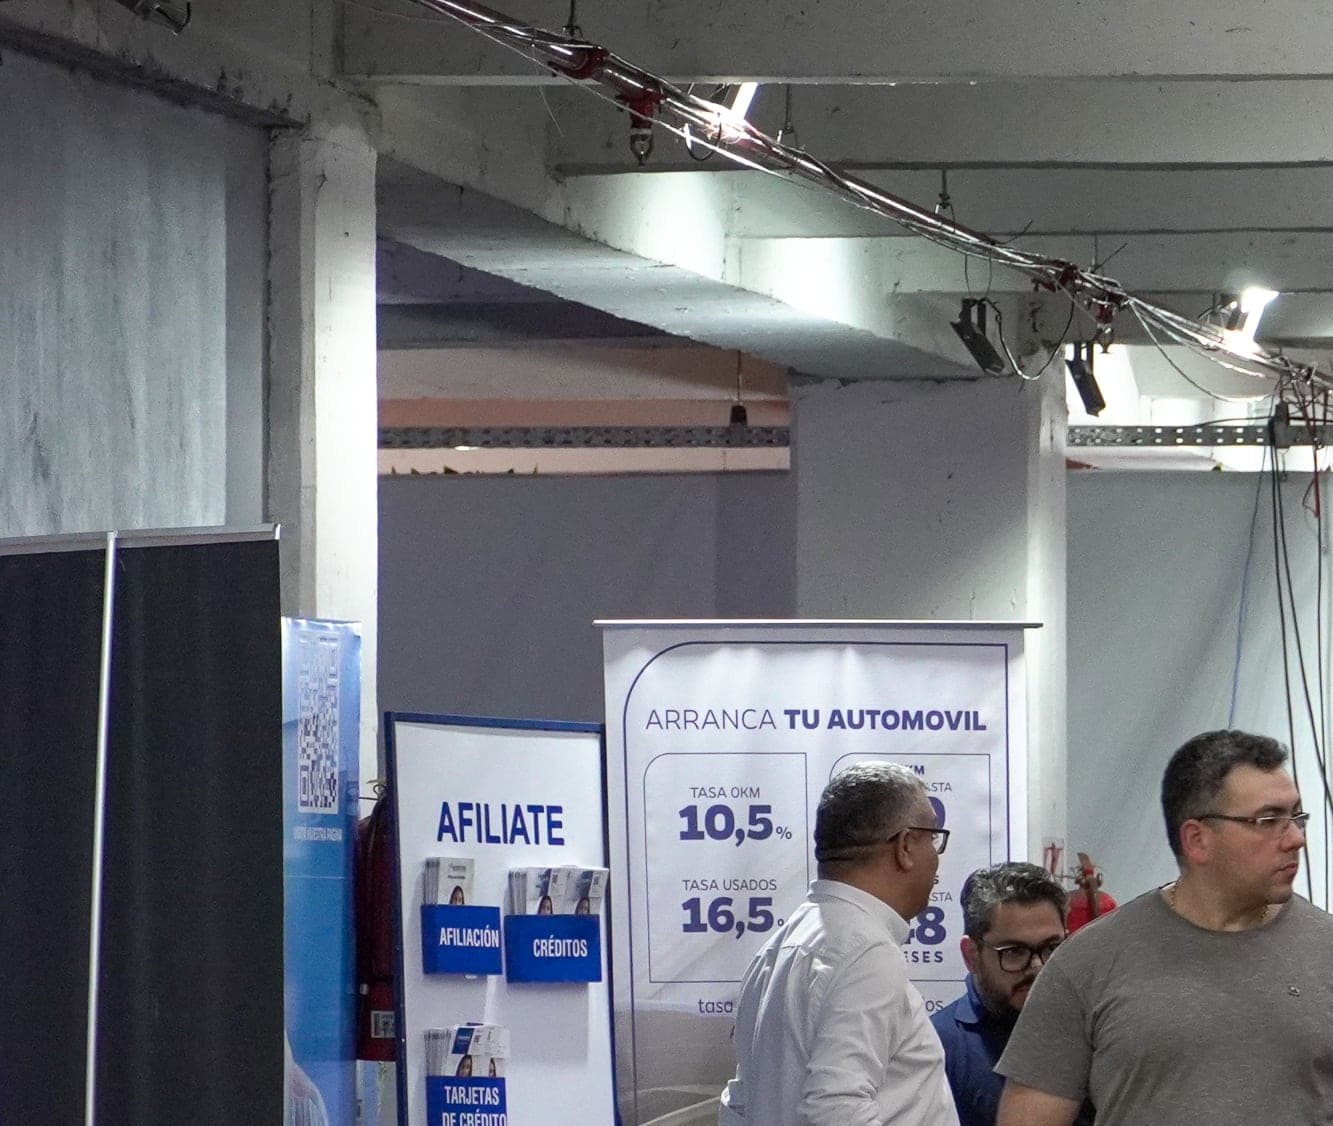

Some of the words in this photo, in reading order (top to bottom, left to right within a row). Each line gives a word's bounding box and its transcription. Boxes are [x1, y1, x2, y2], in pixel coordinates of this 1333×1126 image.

[645, 709, 777, 730] ARRANCA
[784, 710, 820, 730] TU
[827, 710, 987, 731] AUTOMOVIL
[690, 787, 727, 799] TASA
[437, 801, 565, 846] AFILIATE
[682, 879, 719, 891] TASA
[723, 879, 777, 891] USADOS
[439, 924, 500, 948] AFILIACIÓN
[532, 934, 588, 958] CRÉDITOS
[698, 998, 734, 1013] tasa
[444, 1085, 500, 1105] TARJETAS
